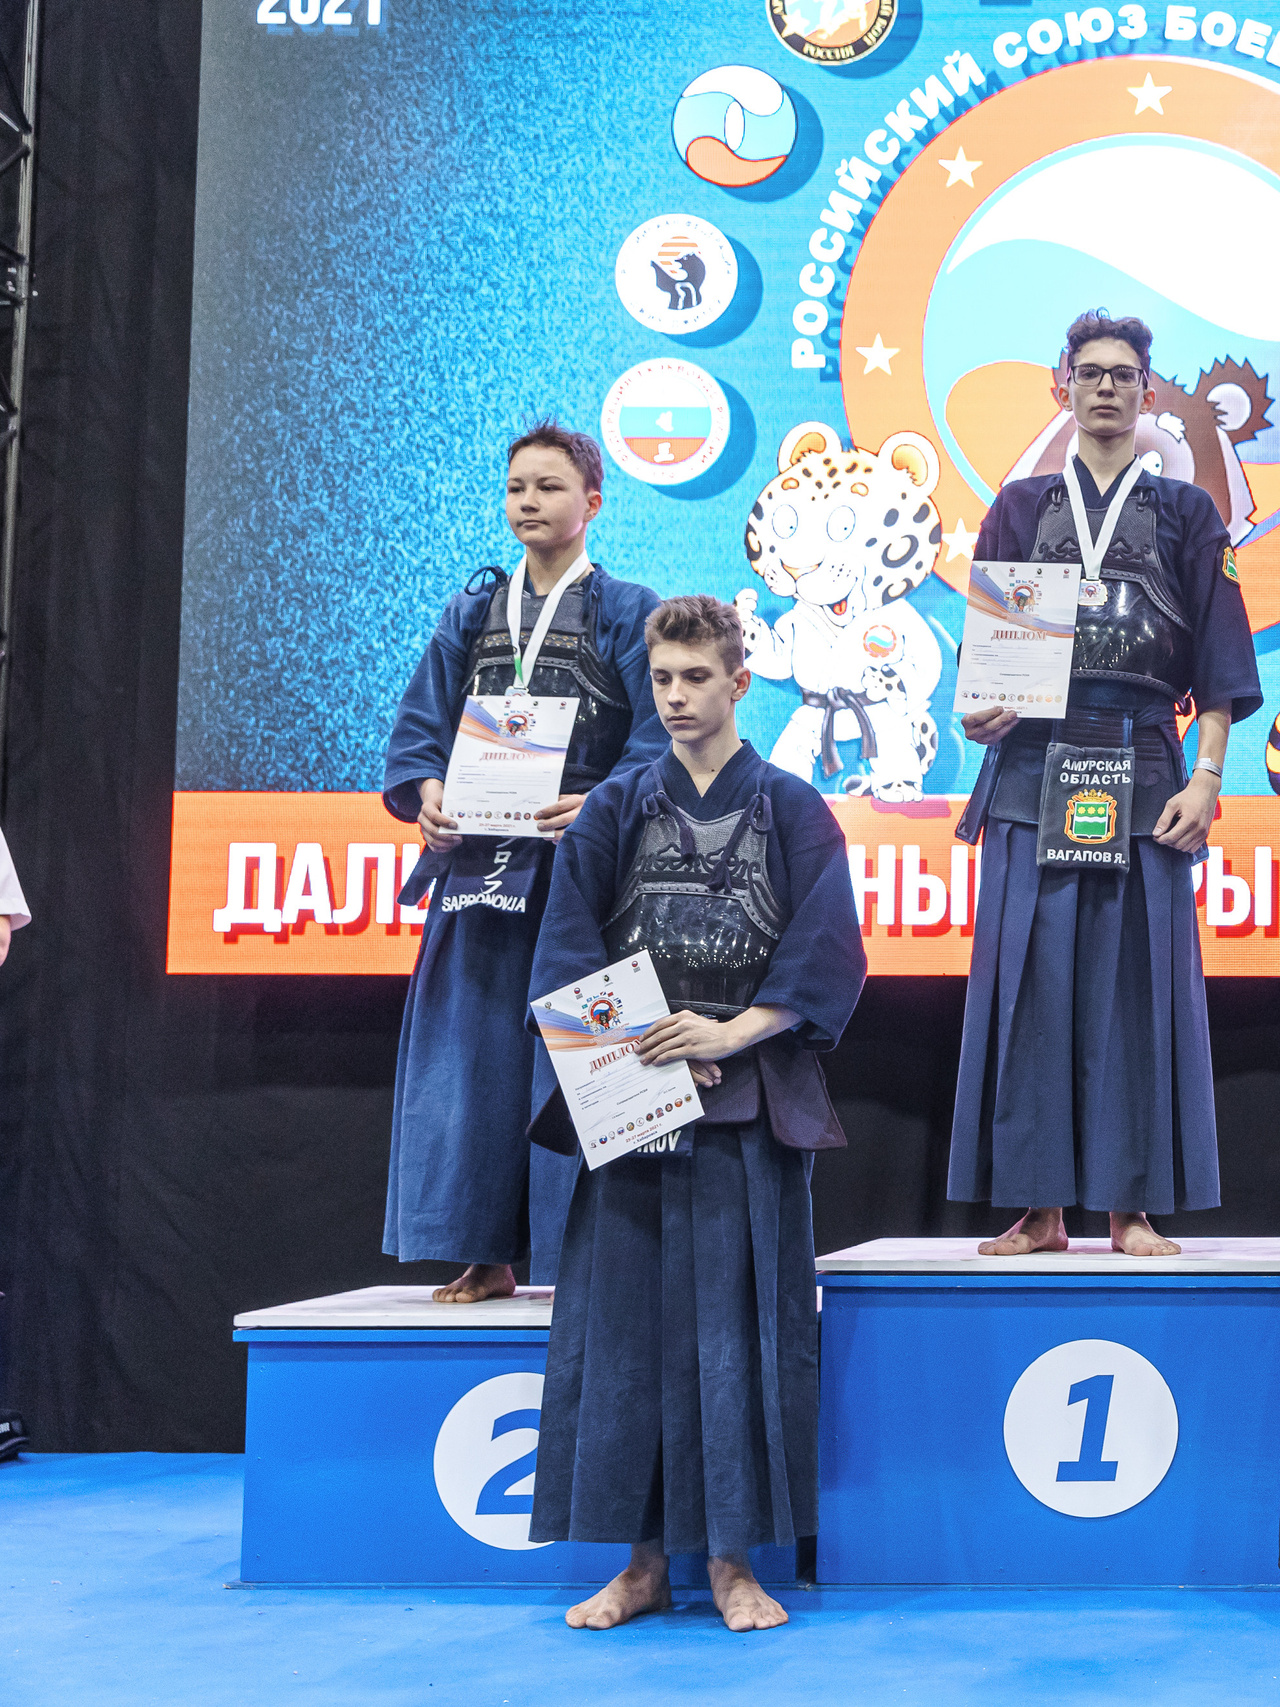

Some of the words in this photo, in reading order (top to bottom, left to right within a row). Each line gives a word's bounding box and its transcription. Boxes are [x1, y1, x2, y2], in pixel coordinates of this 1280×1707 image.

[791, 50, 985, 369] РОССИЙСКИЙ
[992, 2, 1149, 68] СОЮЗ
[990, 629, 1049, 642] ДИПЛОМ
[478, 751, 537, 762] ДИПЛОМ
[1061, 758, 1132, 772] АМУРСКАЯ
[1059, 772, 1132, 786] ОБЛАСТЬ
[1046, 848, 1112, 863] ВАГАПОВ
[1113, 852, 1126, 864] Я.
[1057, 1375, 1118, 1481] 1
[475, 1408, 542, 1515] 2
